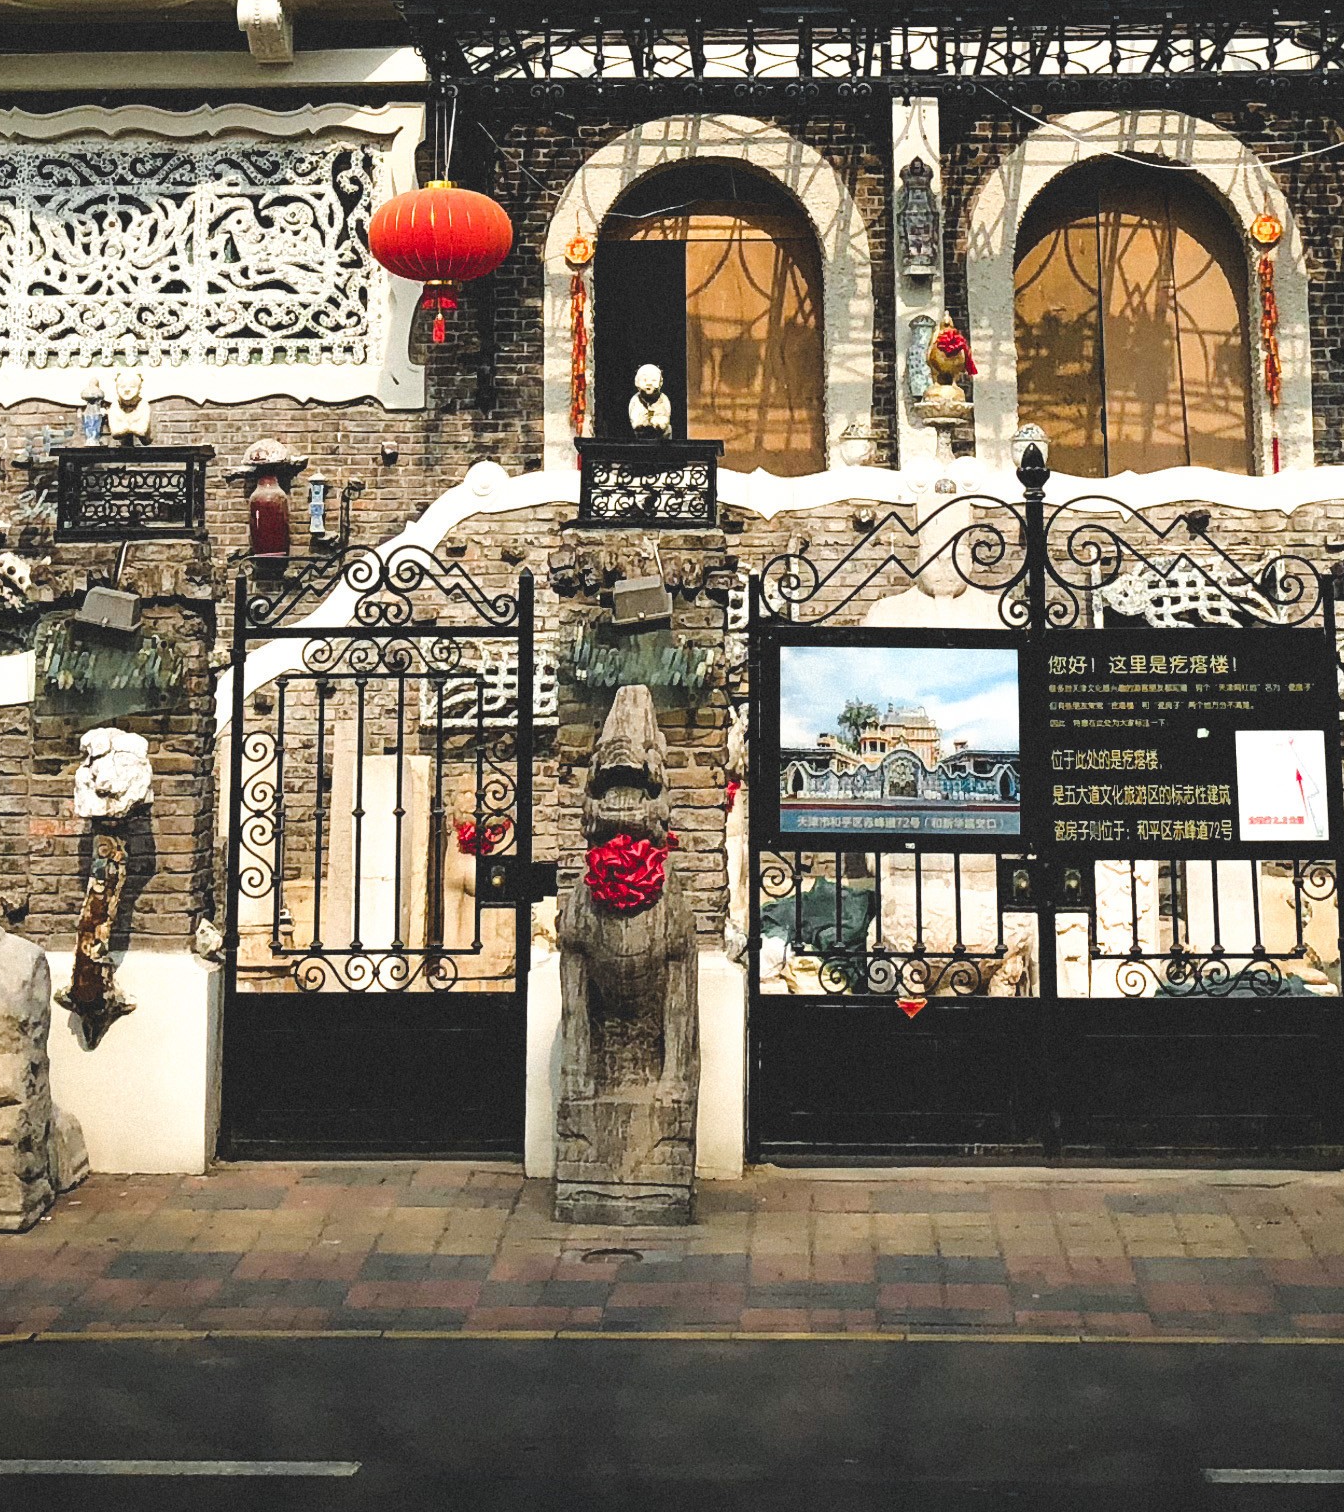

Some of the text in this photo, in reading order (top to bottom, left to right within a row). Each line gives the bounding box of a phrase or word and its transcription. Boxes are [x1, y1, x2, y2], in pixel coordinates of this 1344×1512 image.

[1052, 784, 1231, 805] 是五大道文化旅游区的标志性建筑
